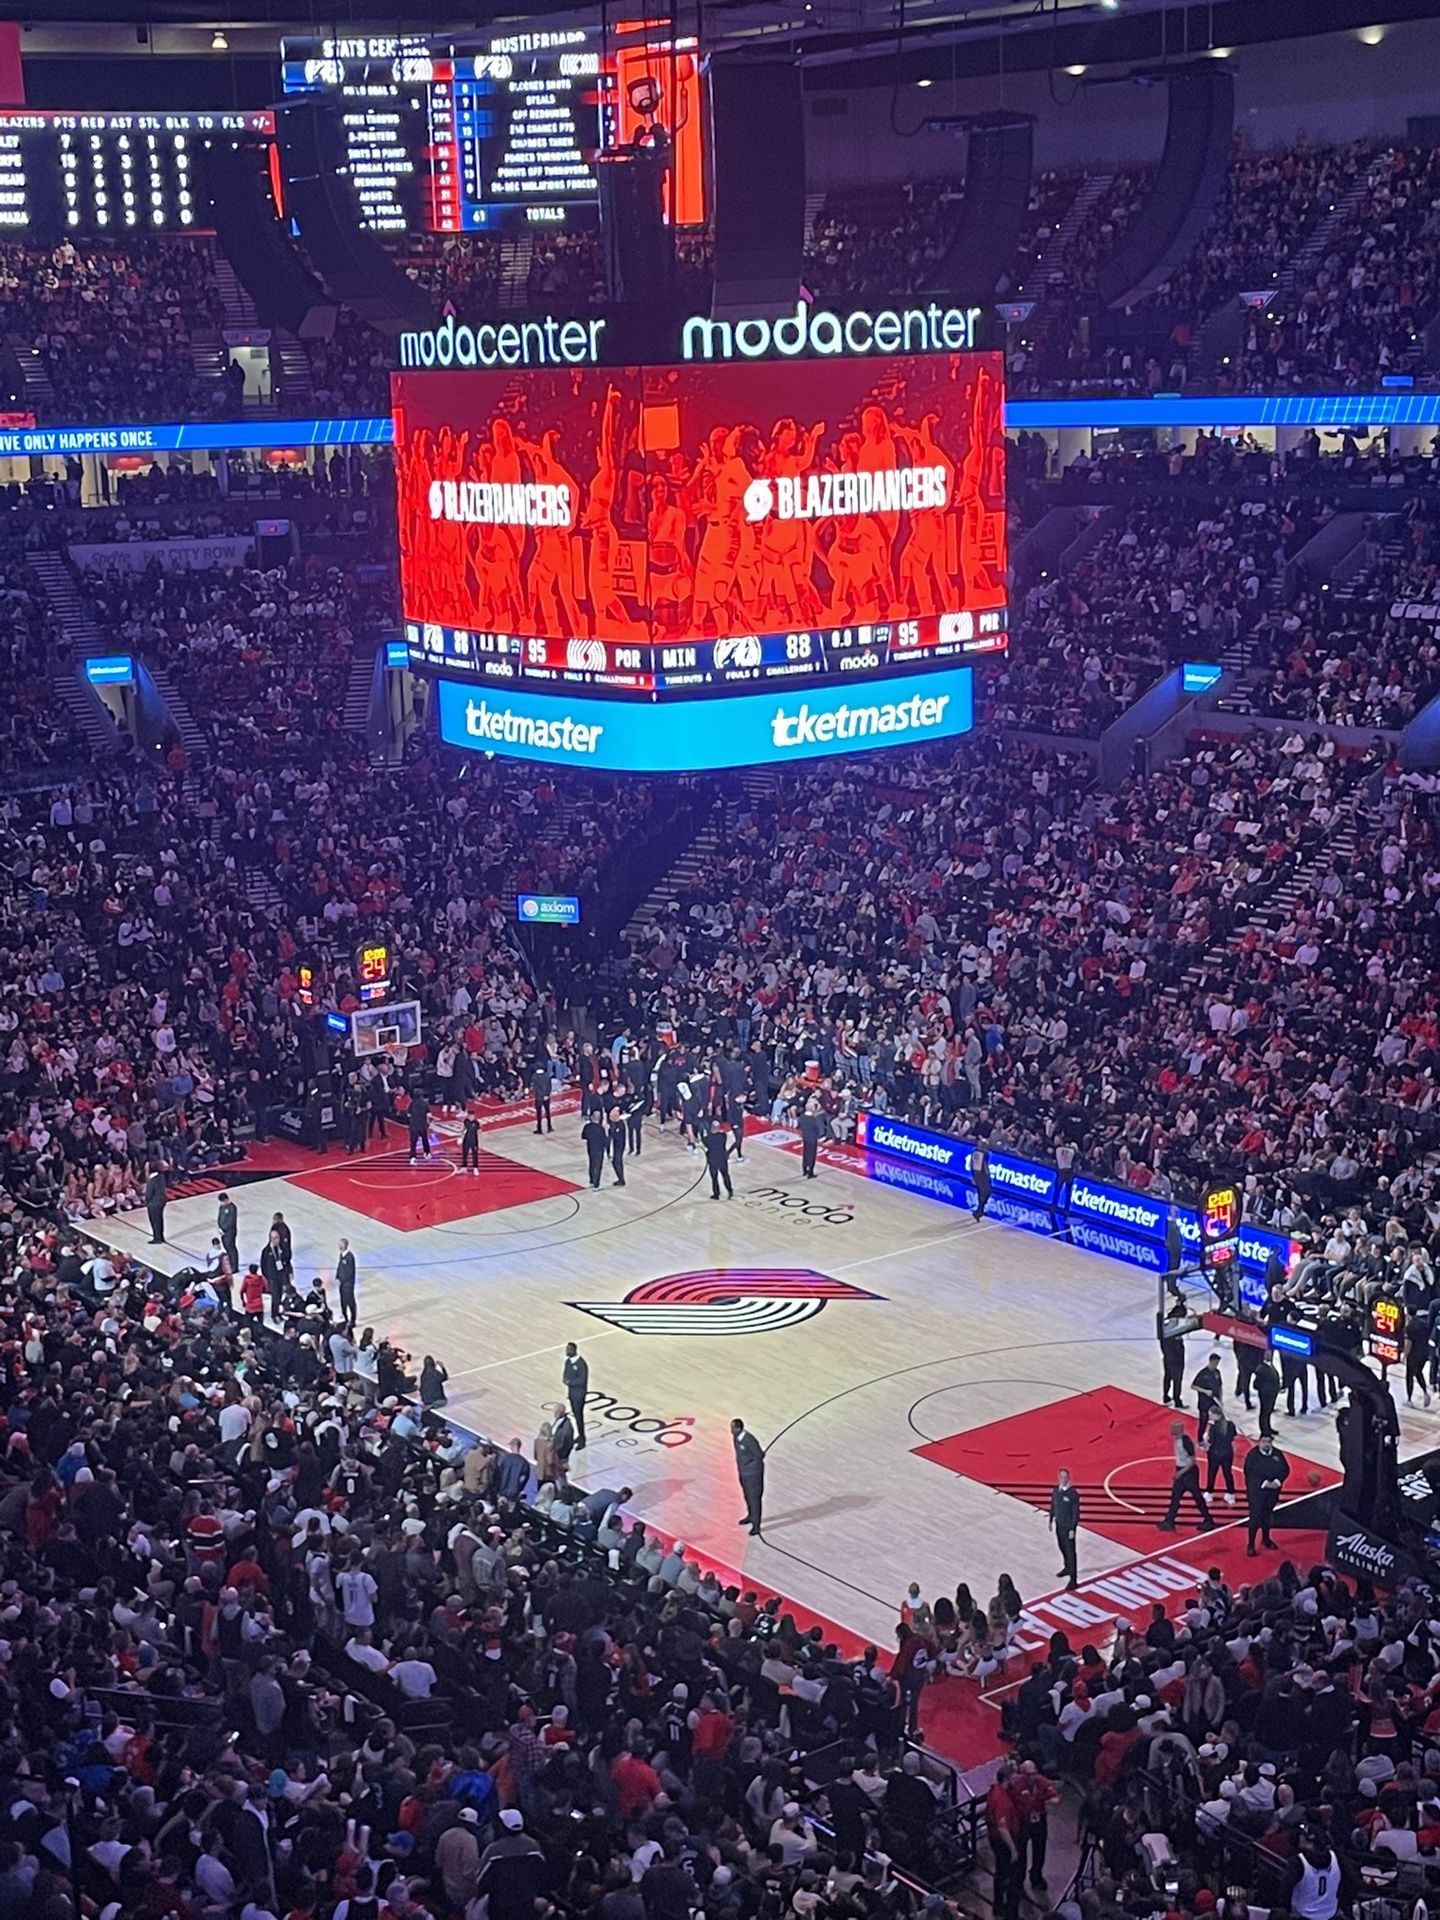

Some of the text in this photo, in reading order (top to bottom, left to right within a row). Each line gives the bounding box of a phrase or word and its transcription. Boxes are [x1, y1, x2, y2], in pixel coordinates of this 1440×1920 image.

[323, 39, 366, 58] STATS
[53, 117, 76, 128] PTS
[110, 117, 132, 128] AST
[139, 117, 160, 129] STL
[198, 117, 213, 127] TO
[61, 134, 70, 149] 7
[90, 135, 100, 149] 3
[119, 135, 129, 149] 4
[93, 155, 103, 169] 2
[121, 155, 131, 169] 3
[95, 174, 105, 188] 6
[151, 173, 161, 187] 2
[66, 192, 76, 206] 7
[95, 192, 106, 206] 0
[123, 192, 134, 206] 0
[151, 192, 162, 206] 0
[179, 191, 190, 206] 0
[125, 210, 136, 225] 3
[526, 207, 566, 221] TOTALS
[400, 314, 606, 367] modacenter
[682, 299, 982, 360] modacenter
[24, 434, 56, 450] ONLY
[60, 431, 117, 449] HAPPENS
[444, 481, 572, 527] BLAZERDANCERS
[775, 465, 947, 520] BLAZERDANCERS
[204, 547, 236, 559] ROW
[528, 638, 547, 664] 95
[615, 648, 642, 669] POR
[662, 647, 696, 669] MIN
[785, 633, 812, 660] 88
[898, 620, 919, 647] 95
[840, 653, 880, 671] moda
[540, 900, 576, 915] axiom
[362, 959, 386, 980] 24
[873, 1126, 953, 1165] ticketmaster
[964, 1153, 1052, 1195] tetmaster
[748, 1187, 855, 1226] moda
[1070, 1184, 1160, 1229] icketmaster
[1206, 1204, 1232, 1238] 24
[1375, 1312, 1395, 1333] 24
[584, 1390, 695, 1449] moda
[1336, 1533, 1394, 1567] Alaska
[1337, 1551, 1386, 1578] AIRLINES
